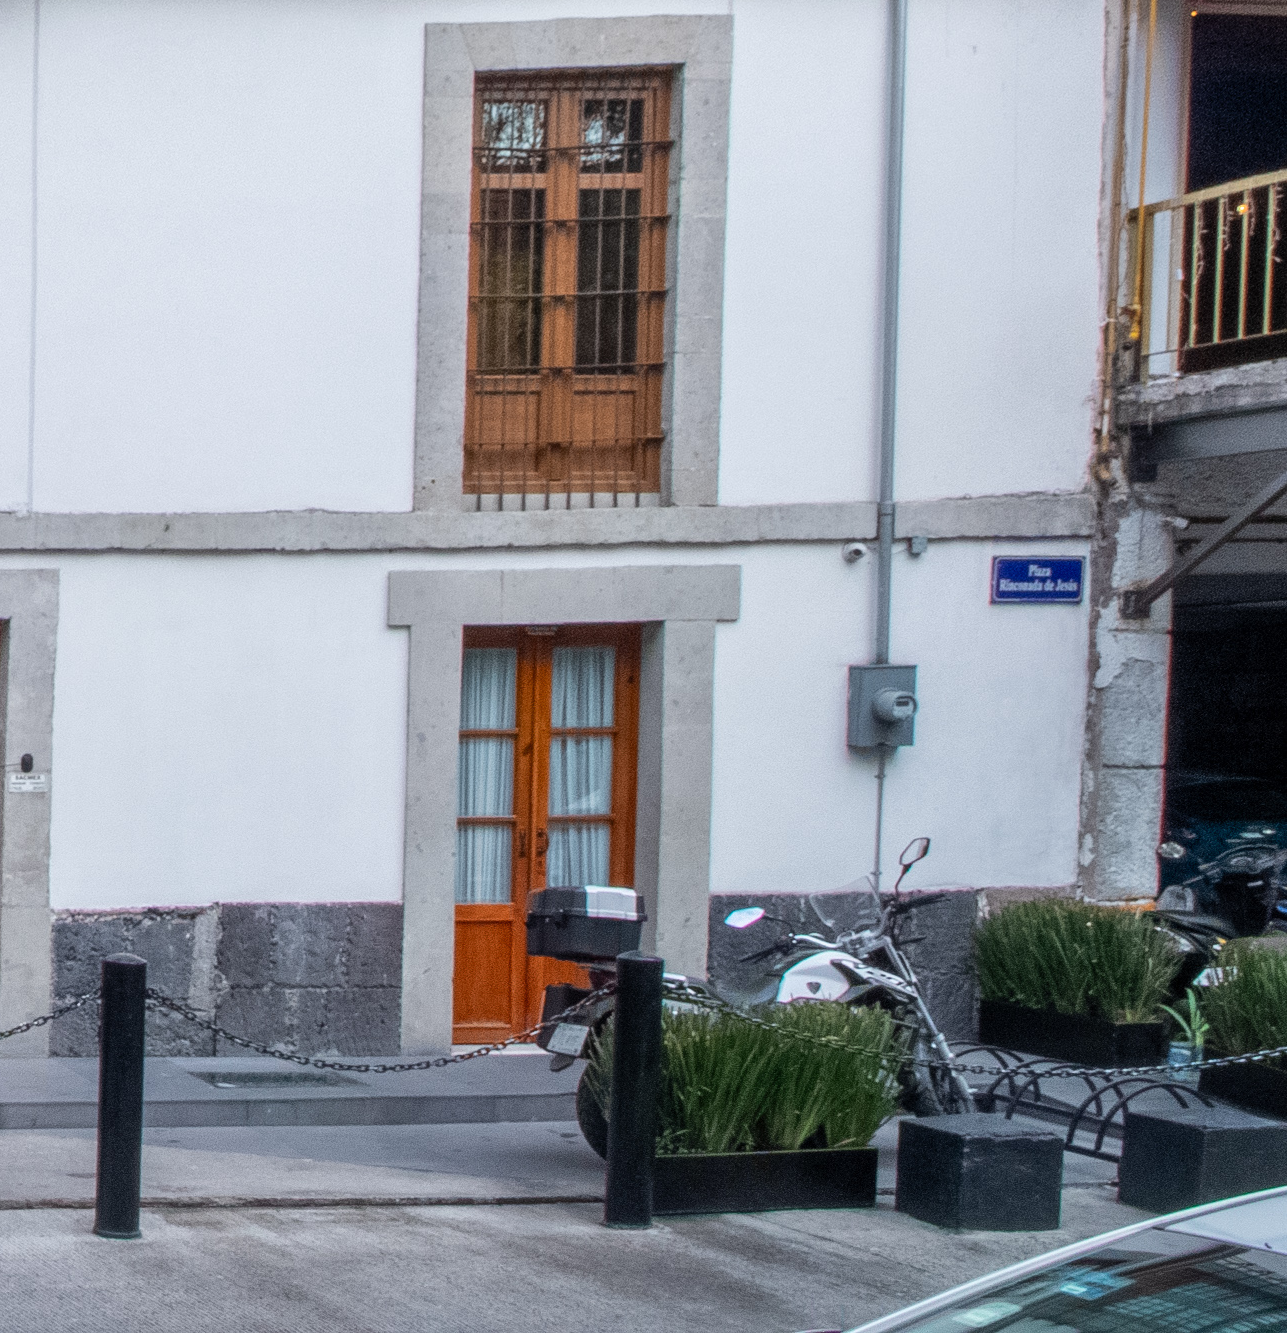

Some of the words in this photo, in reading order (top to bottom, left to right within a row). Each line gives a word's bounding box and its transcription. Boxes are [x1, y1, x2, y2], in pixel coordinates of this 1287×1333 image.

[1028, 564, 1051, 577] Plaza
[999, 579, 1042, 591] Rinconada
[1044, 579, 1055, 591] de
